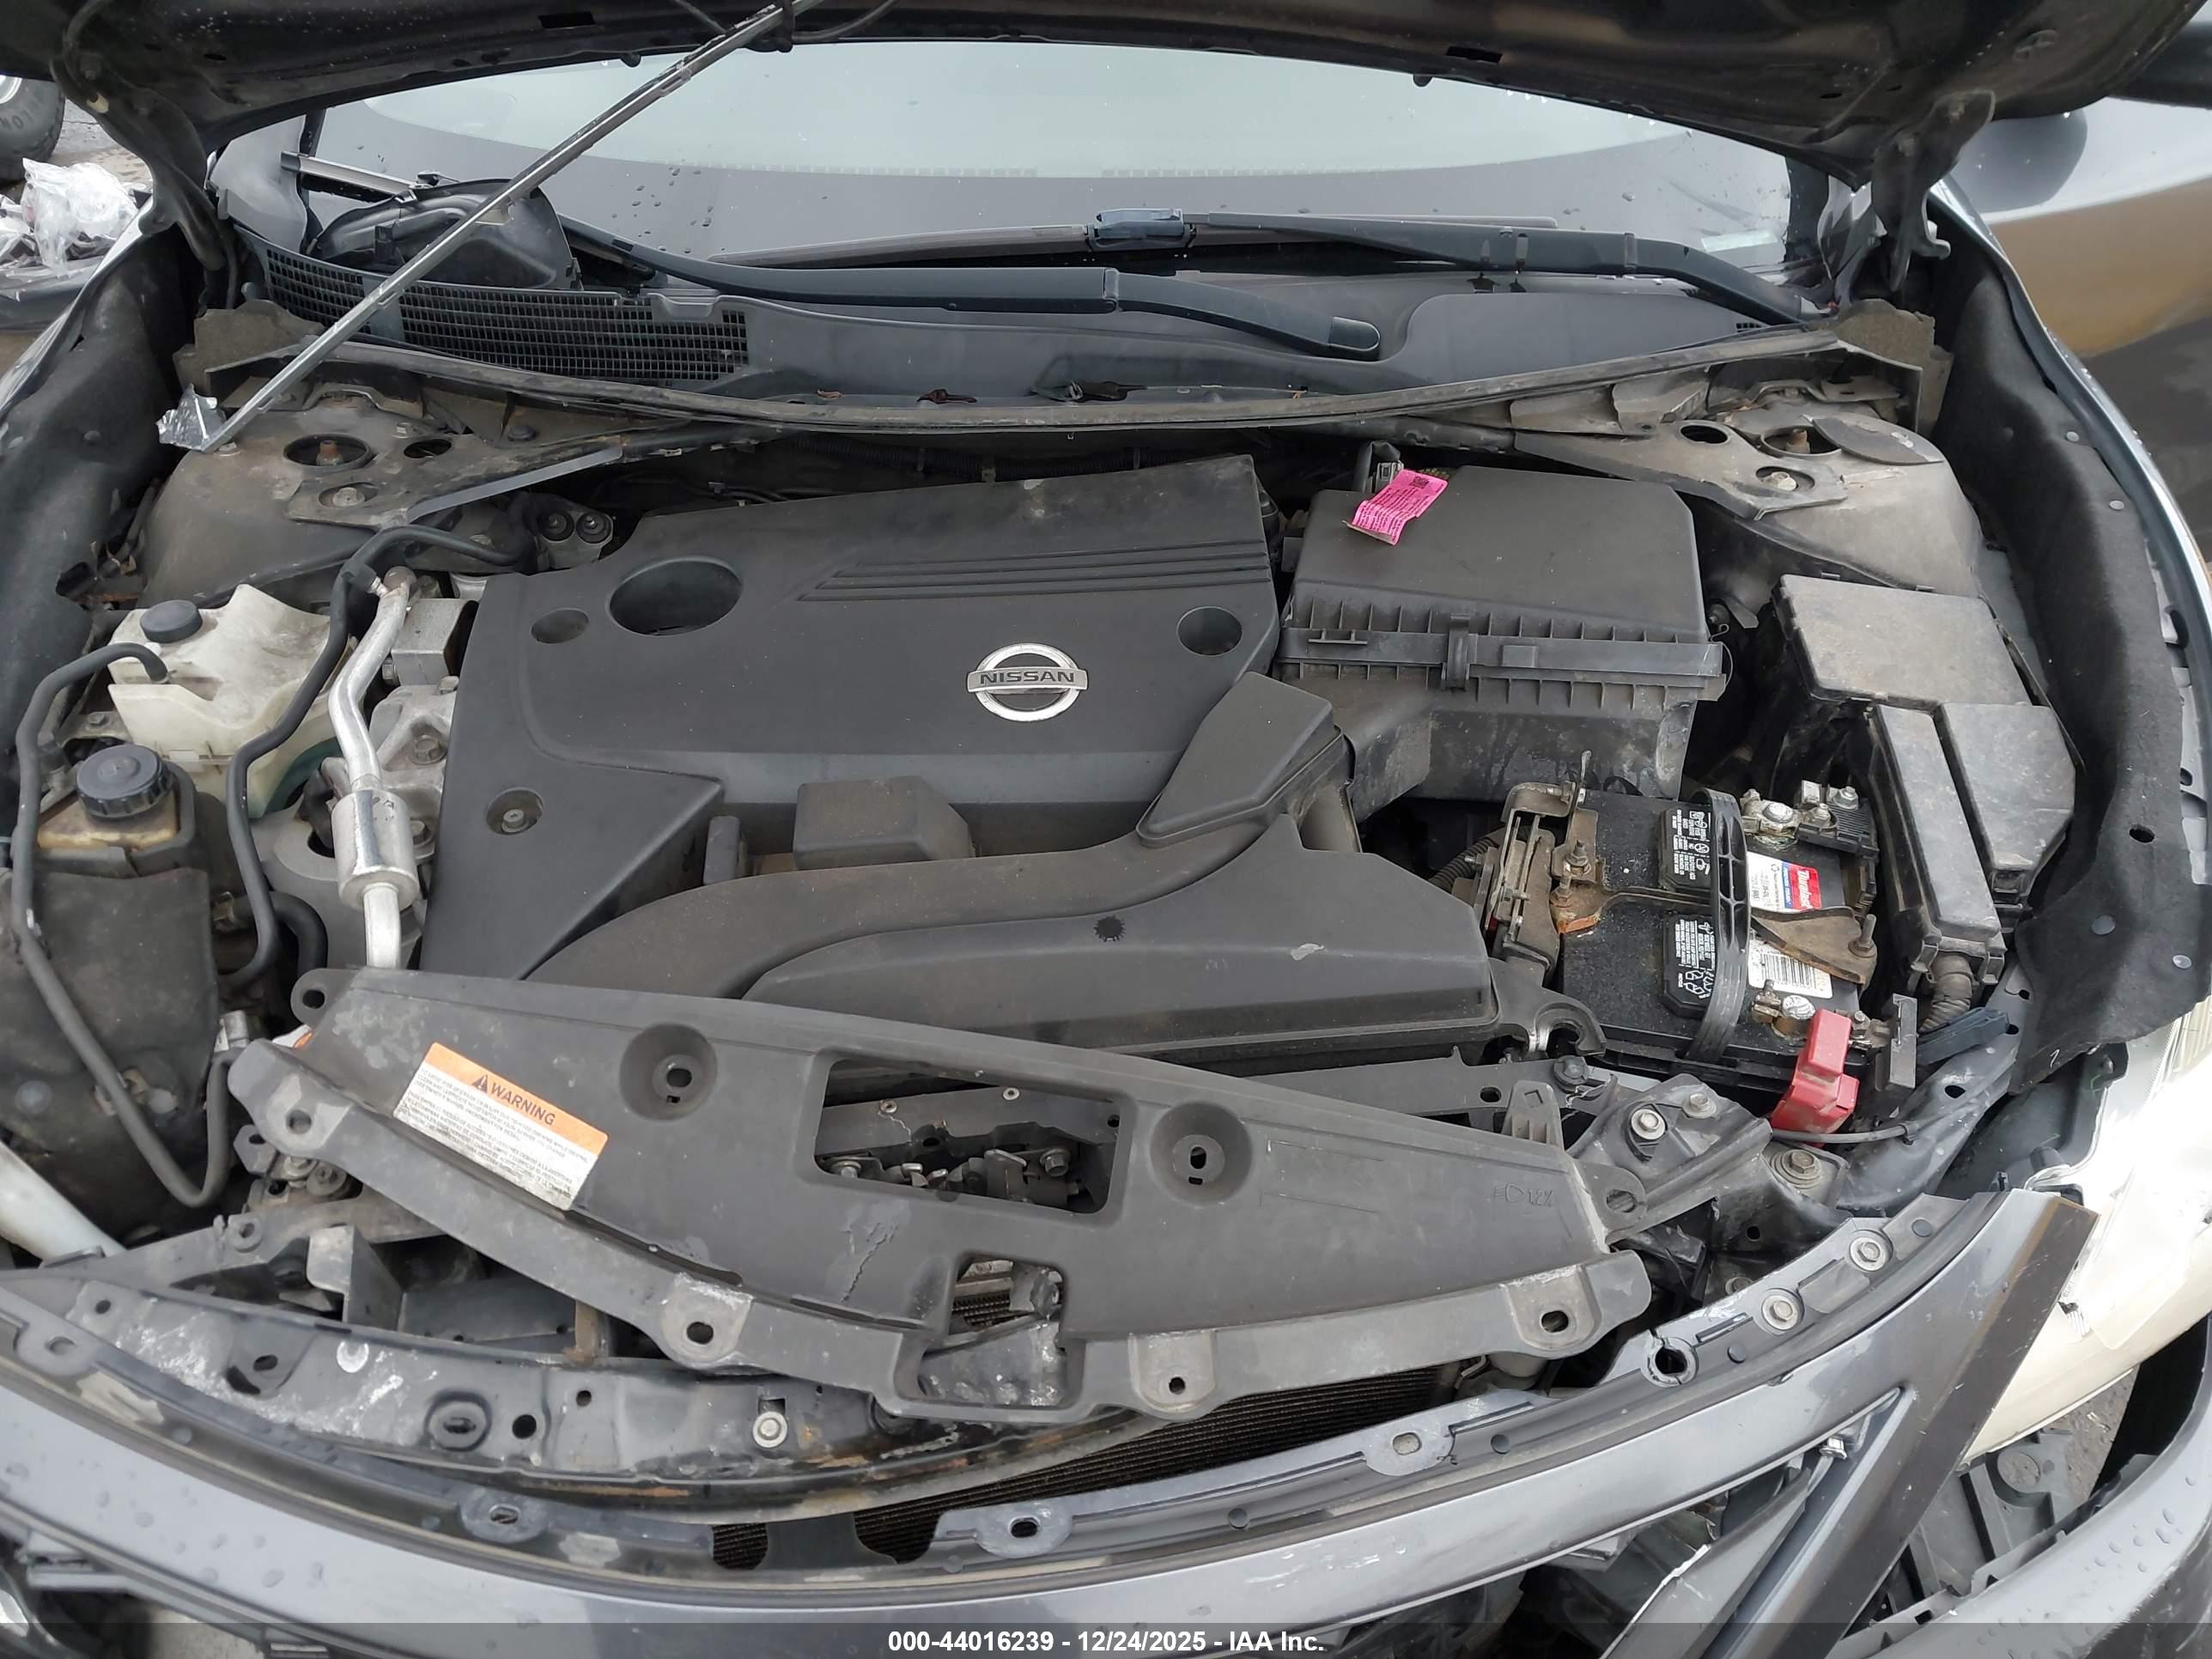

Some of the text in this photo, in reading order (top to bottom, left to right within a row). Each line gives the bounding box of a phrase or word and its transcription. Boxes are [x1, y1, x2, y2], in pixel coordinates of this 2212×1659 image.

[980, 671, 1074, 684] NISSAN
[1797, 870, 1814, 909] Duralast
[491, 1081, 556, 1126] WARNING
